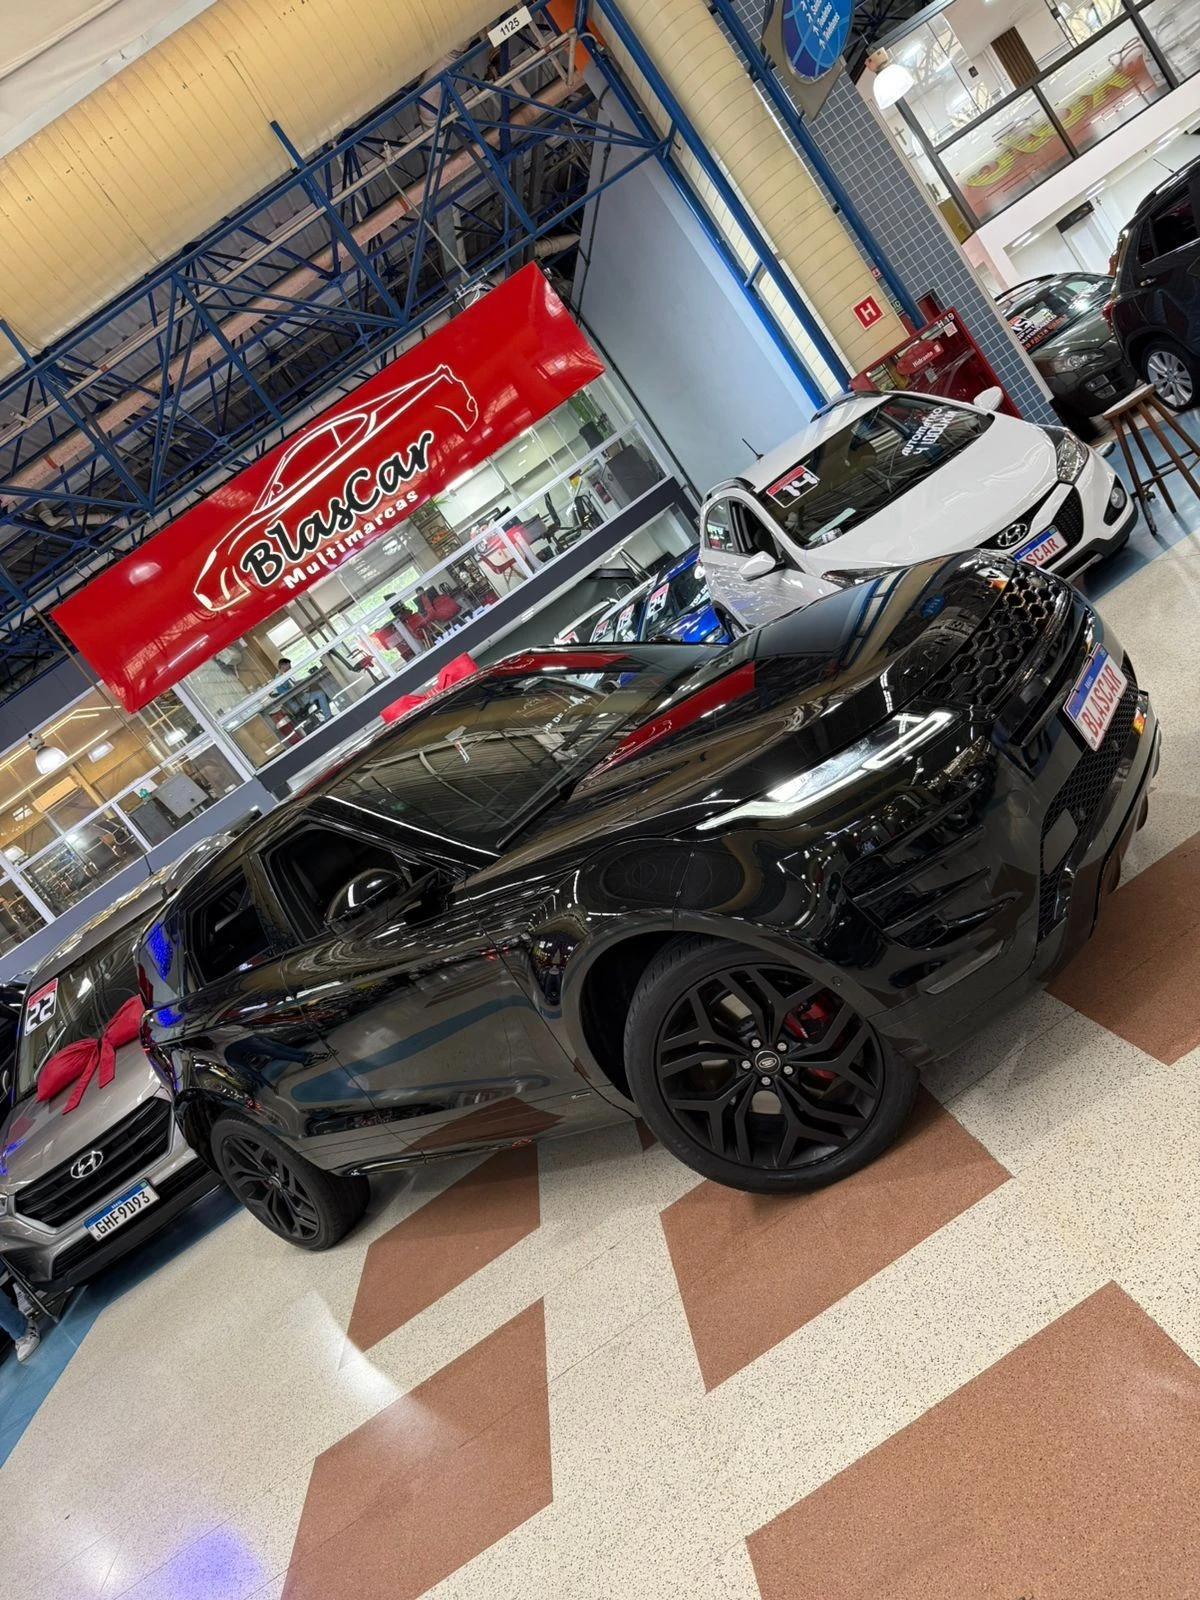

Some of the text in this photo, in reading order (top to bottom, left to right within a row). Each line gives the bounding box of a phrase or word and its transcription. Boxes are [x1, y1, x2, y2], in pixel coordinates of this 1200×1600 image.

[499, 17, 520, 36] 1125
[860, 302, 877, 321] H
[945, 312, 955, 323] 19
[783, 472, 818, 497] 14
[239, 430, 434, 587] BlasCar
[283, 490, 419, 590] Multimarcas
[1081, 664, 1122, 738] BLASCAR
[26, 992, 55, 1032] 22
[95, 1191, 151, 1235] GHF9D93
